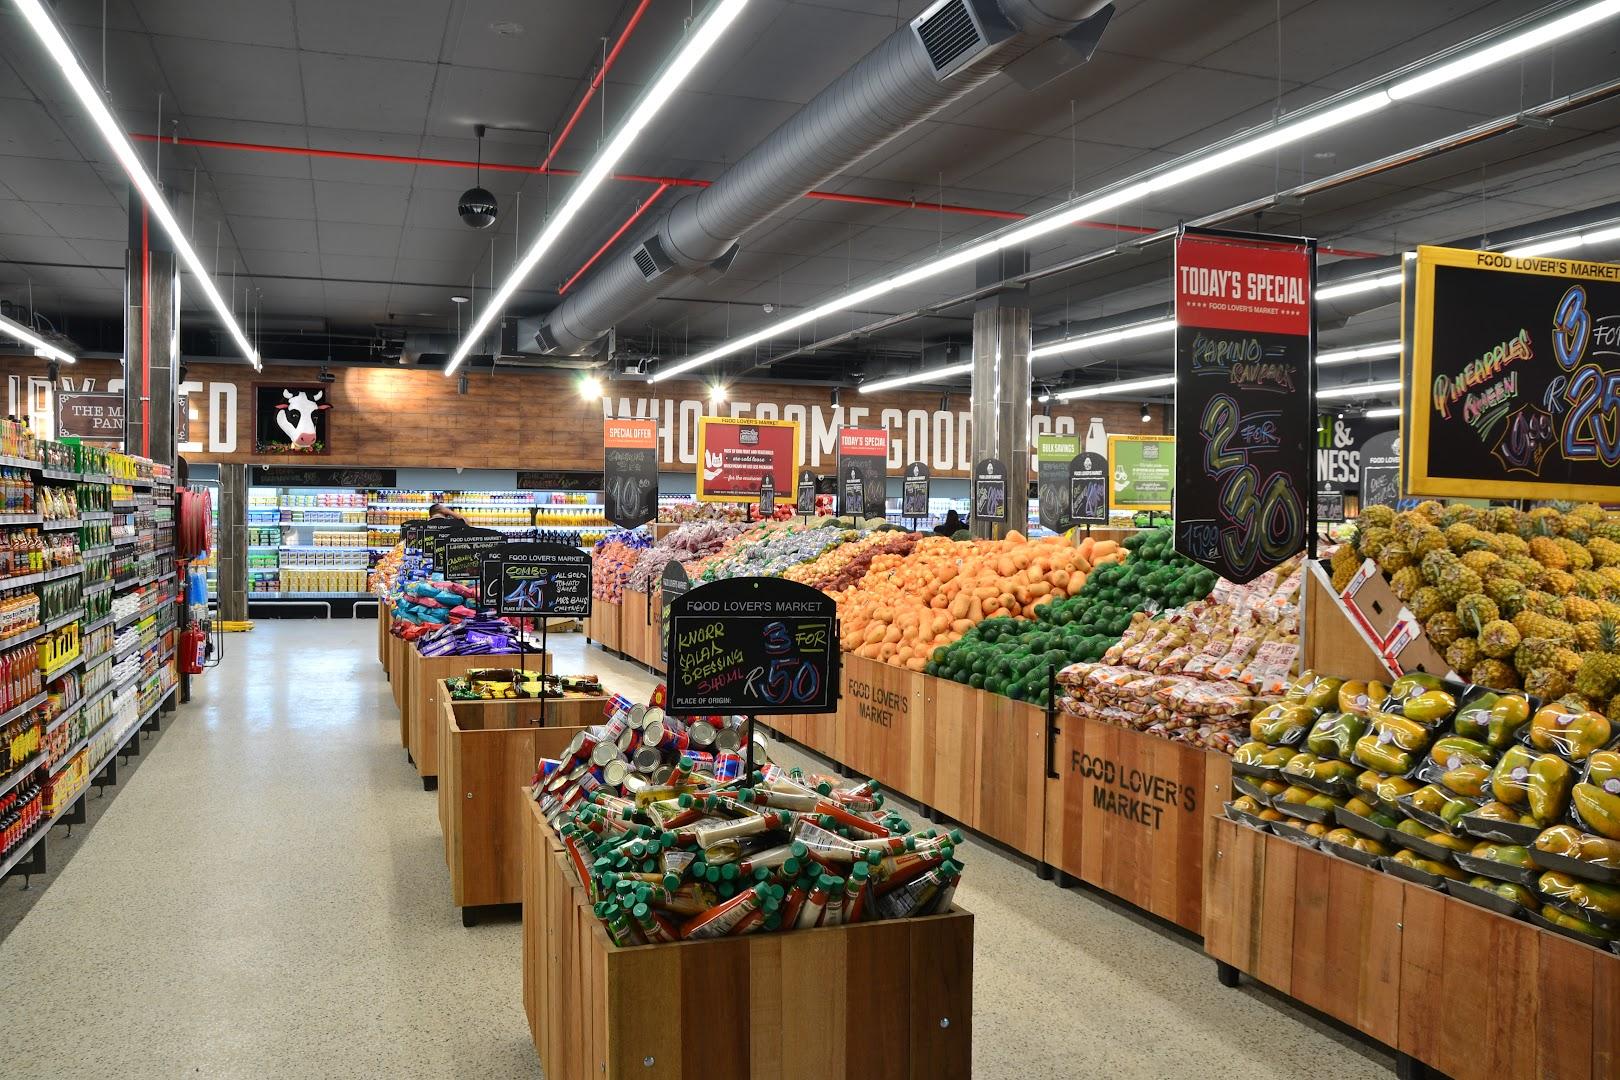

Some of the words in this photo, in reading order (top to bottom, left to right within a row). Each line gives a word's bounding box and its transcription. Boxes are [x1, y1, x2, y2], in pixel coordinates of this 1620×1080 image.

[1477, 254, 1512, 268] FOOD
[1516, 258, 1567, 274] LOVER'S
[1571, 263, 1620, 279] MARKET
[1180, 266, 1242, 299] TODAY'S
[1247, 273, 1305, 305] SPECIAL
[1209, 302, 1227, 311] FOOD
[1228, 304, 1253, 313] LOVER'S
[1254, 306, 1279, 315] MARKET
[1552, 285, 1591, 372] 3
[1433, 328, 1533, 420] PINEAPPLES
[72, 405, 103, 416] THE
[107, 406, 125, 417] M
[1463, 371, 1518, 426] QUEEN
[610, 428, 632, 438] SPECIAL
[634, 429, 652, 438] OFFER
[842, 436, 863, 446] TODAY'S
[865, 437, 886, 447] SPECIAL
[1200, 393, 1249, 480] 2
[1219, 464, 1305, 576] 30
[506, 566, 548, 576] COMBO
[504, 578, 548, 610] 45
[686, 602, 720, 612] FOOD
[724, 602, 772, 612] LOVER'S
[776, 602, 822, 612] MARKET
[678, 622, 724, 652] KNORR
[762, 622, 792, 654] 3
[795, 630, 827, 646] FOR
[682, 648, 744, 686] DRESSING
[697, 668, 744, 695] 340ML
[744, 666, 764, 698] R
[759, 657, 820, 704] 50
[848, 679, 870, 700] FOOD
[872, 686, 908, 714] LOVER'S
[860, 702, 893, 728] MARKET
[1072, 750, 1116, 784] FOOD
[1120, 765, 1196, 812] LOVER'S
[1094, 785, 1163, 830] MARKET
